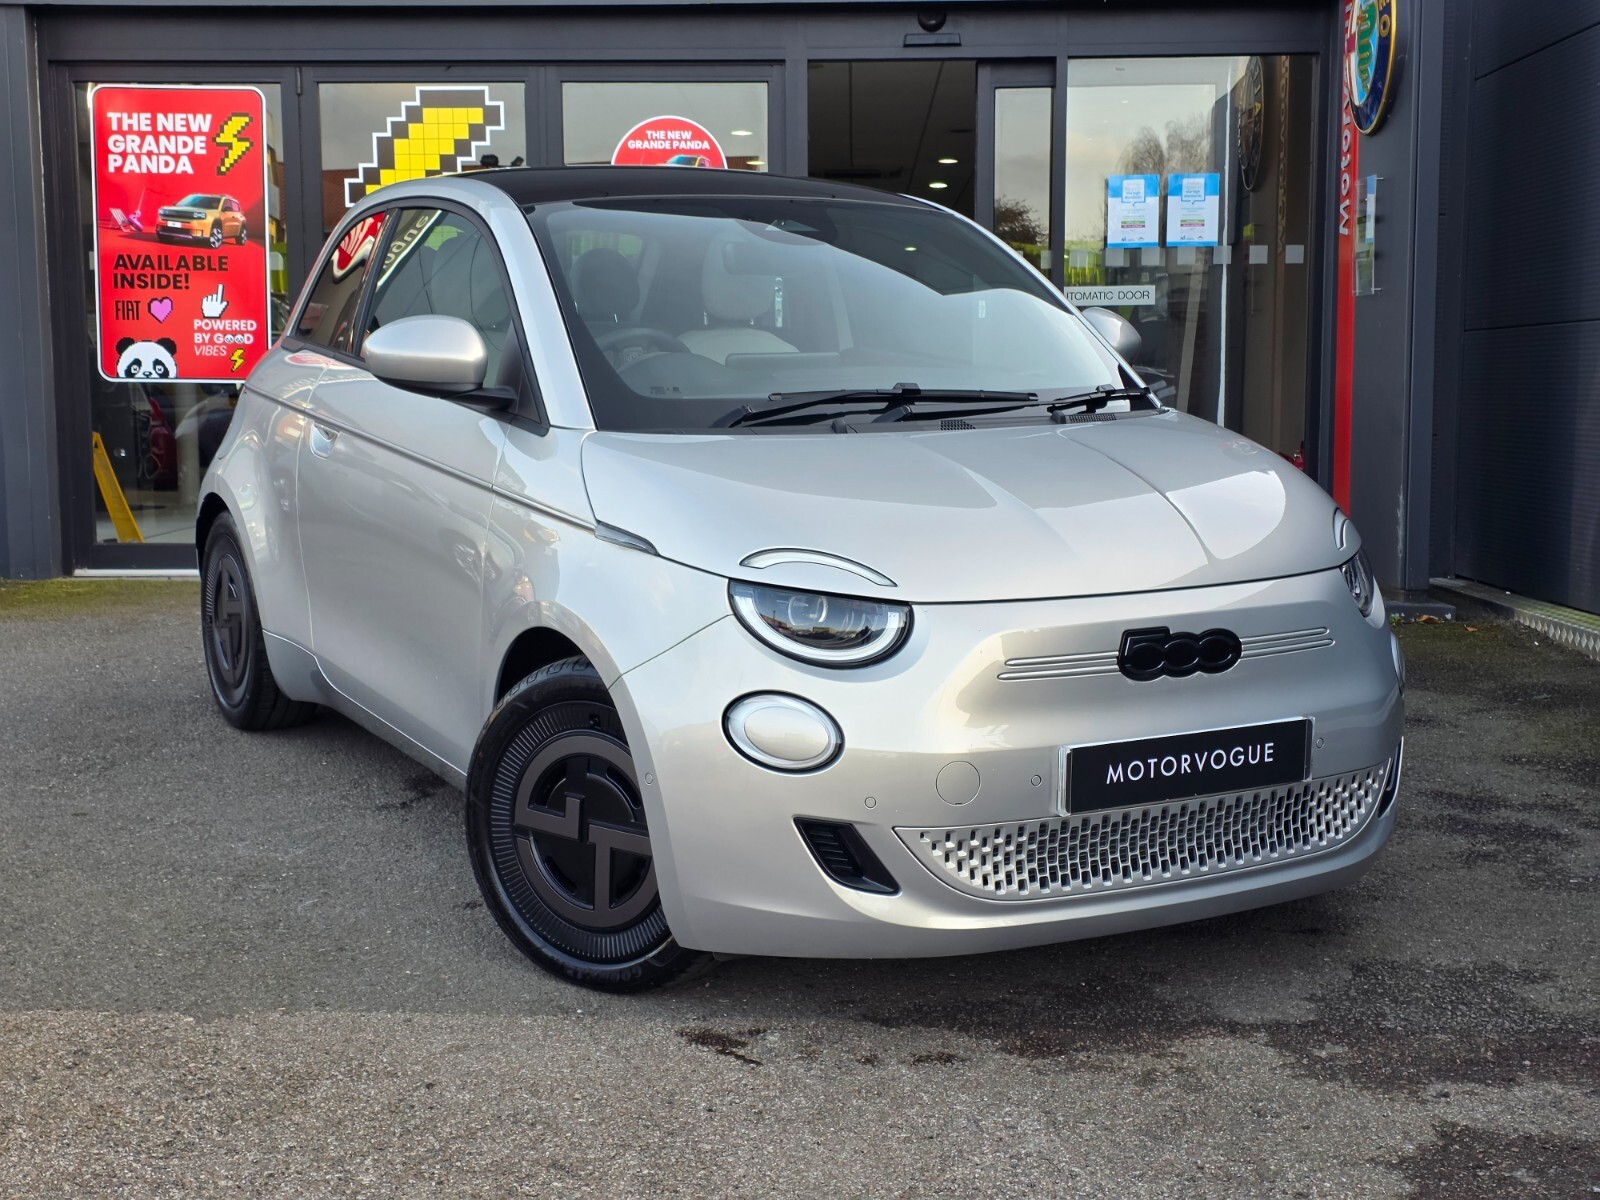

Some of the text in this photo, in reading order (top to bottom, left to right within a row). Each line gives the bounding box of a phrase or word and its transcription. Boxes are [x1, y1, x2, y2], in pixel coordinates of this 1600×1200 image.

[107, 112, 212, 133] THE NEW
[646, 130, 692, 140] THE NEW
[107, 134, 207, 154] GRANDE
[627, 140, 710, 150] GRANDE PANDA
[107, 154, 194, 174] PANDA
[113, 254, 229, 271] AVAILABLE
[113, 273, 190, 290] INSIDE!
[1118, 290, 1150, 300] DOOR
[115, 300, 141, 320] FIAT
[193, 319, 257, 331] POWERED
[194, 332, 212, 344] BY
[194, 345, 227, 356] VIBES
[1117, 626, 1242, 682] 500
[1106, 742, 1275, 784] MOTORVOGUE
